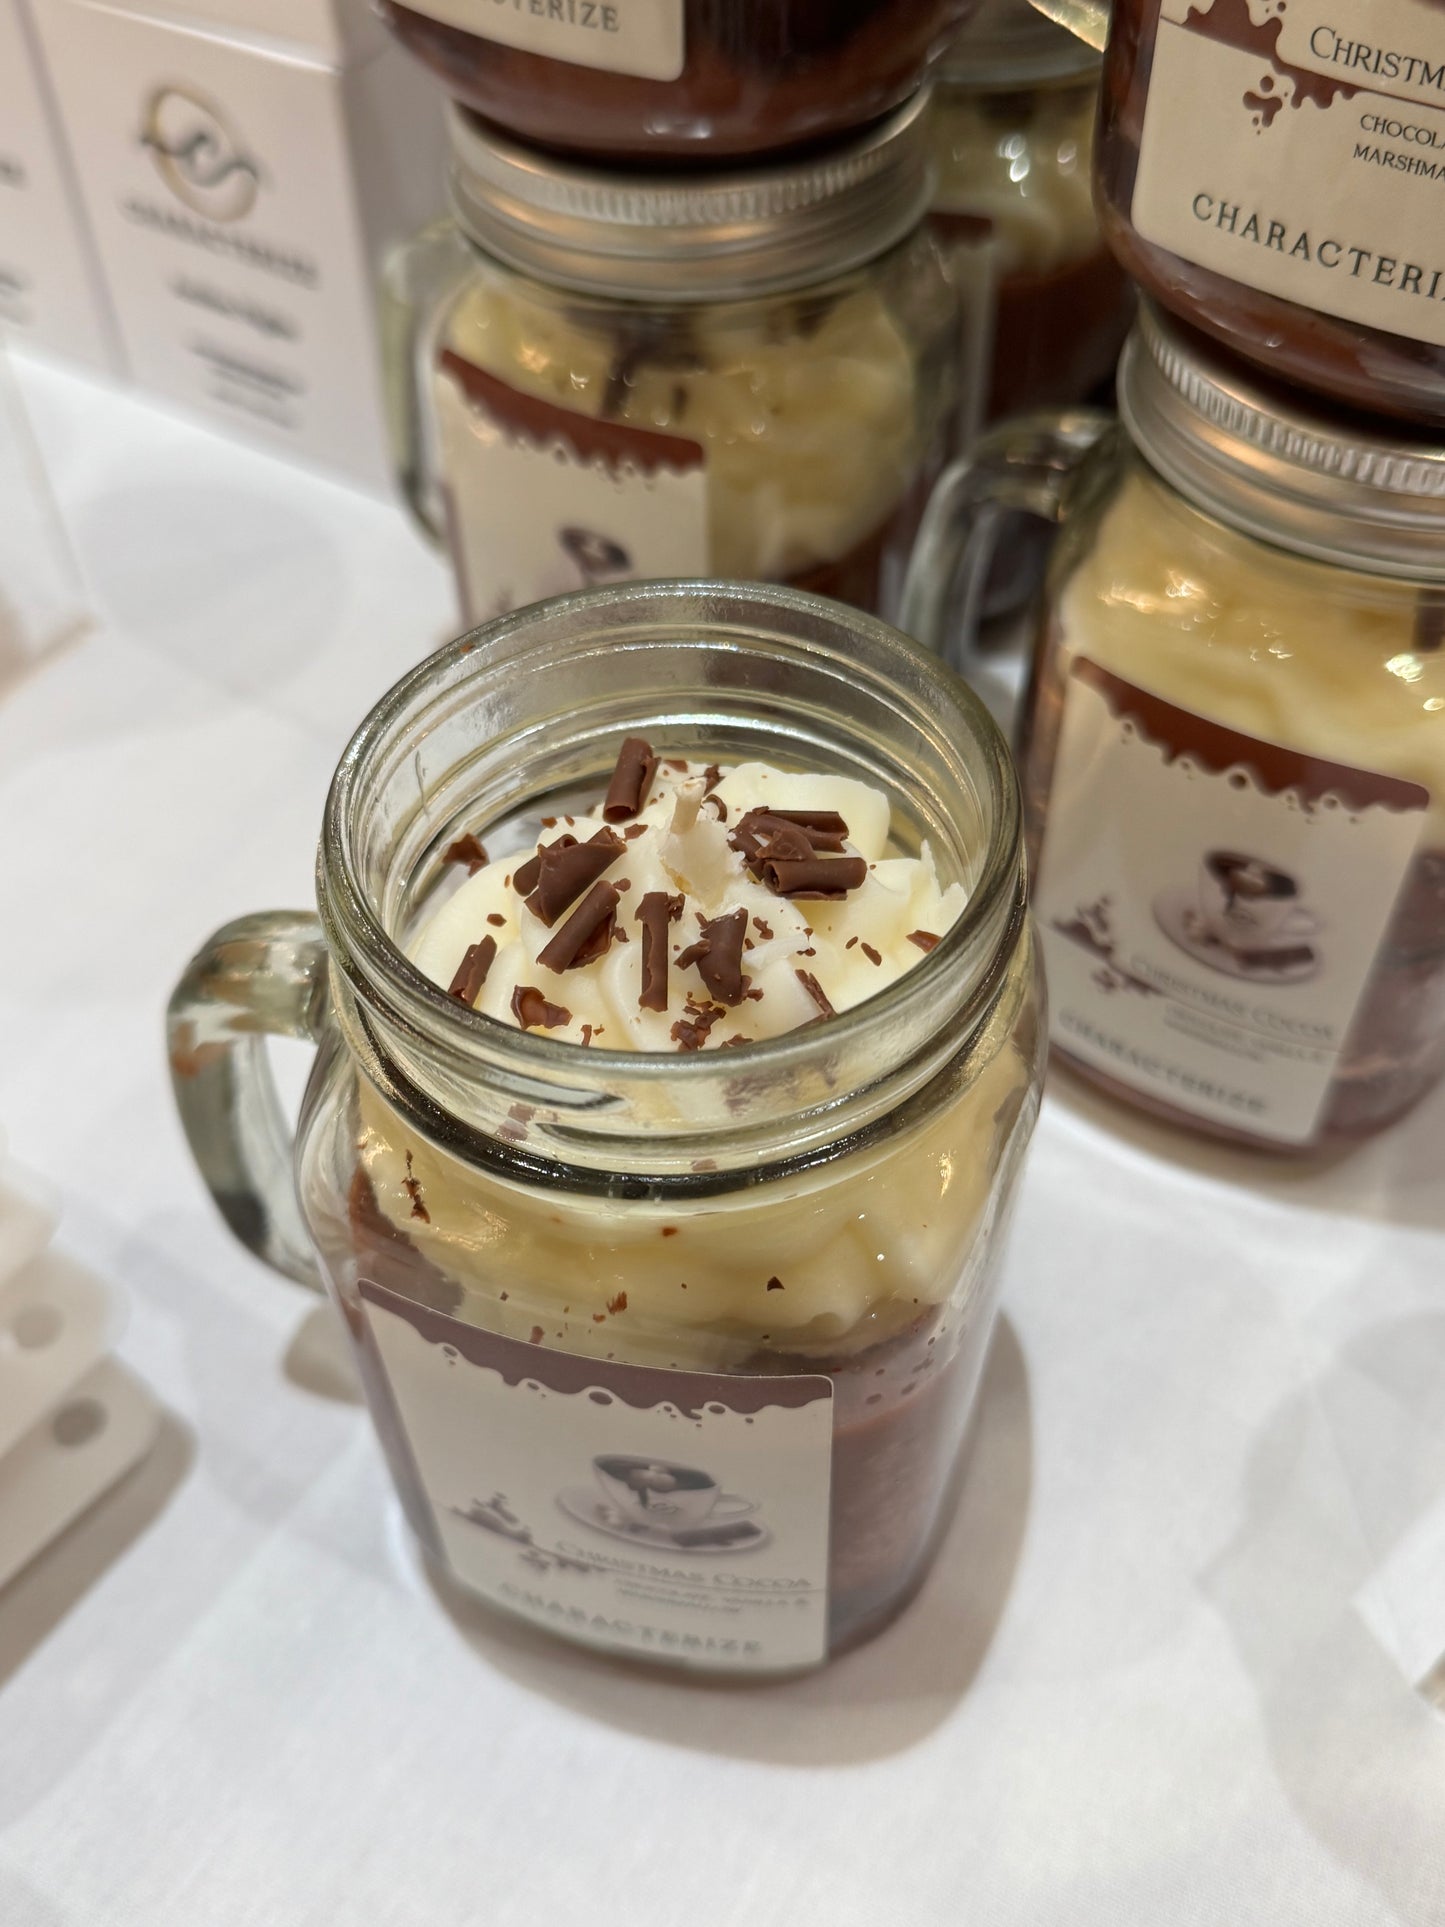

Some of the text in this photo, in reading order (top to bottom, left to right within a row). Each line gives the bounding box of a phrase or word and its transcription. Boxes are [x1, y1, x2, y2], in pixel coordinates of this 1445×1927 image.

[1309, 26, 1445, 91] CHRISTM
[1191, 192, 1445, 301] CHARACTERI
[554, 1540, 812, 1588] CHRISTMAS COCOA
